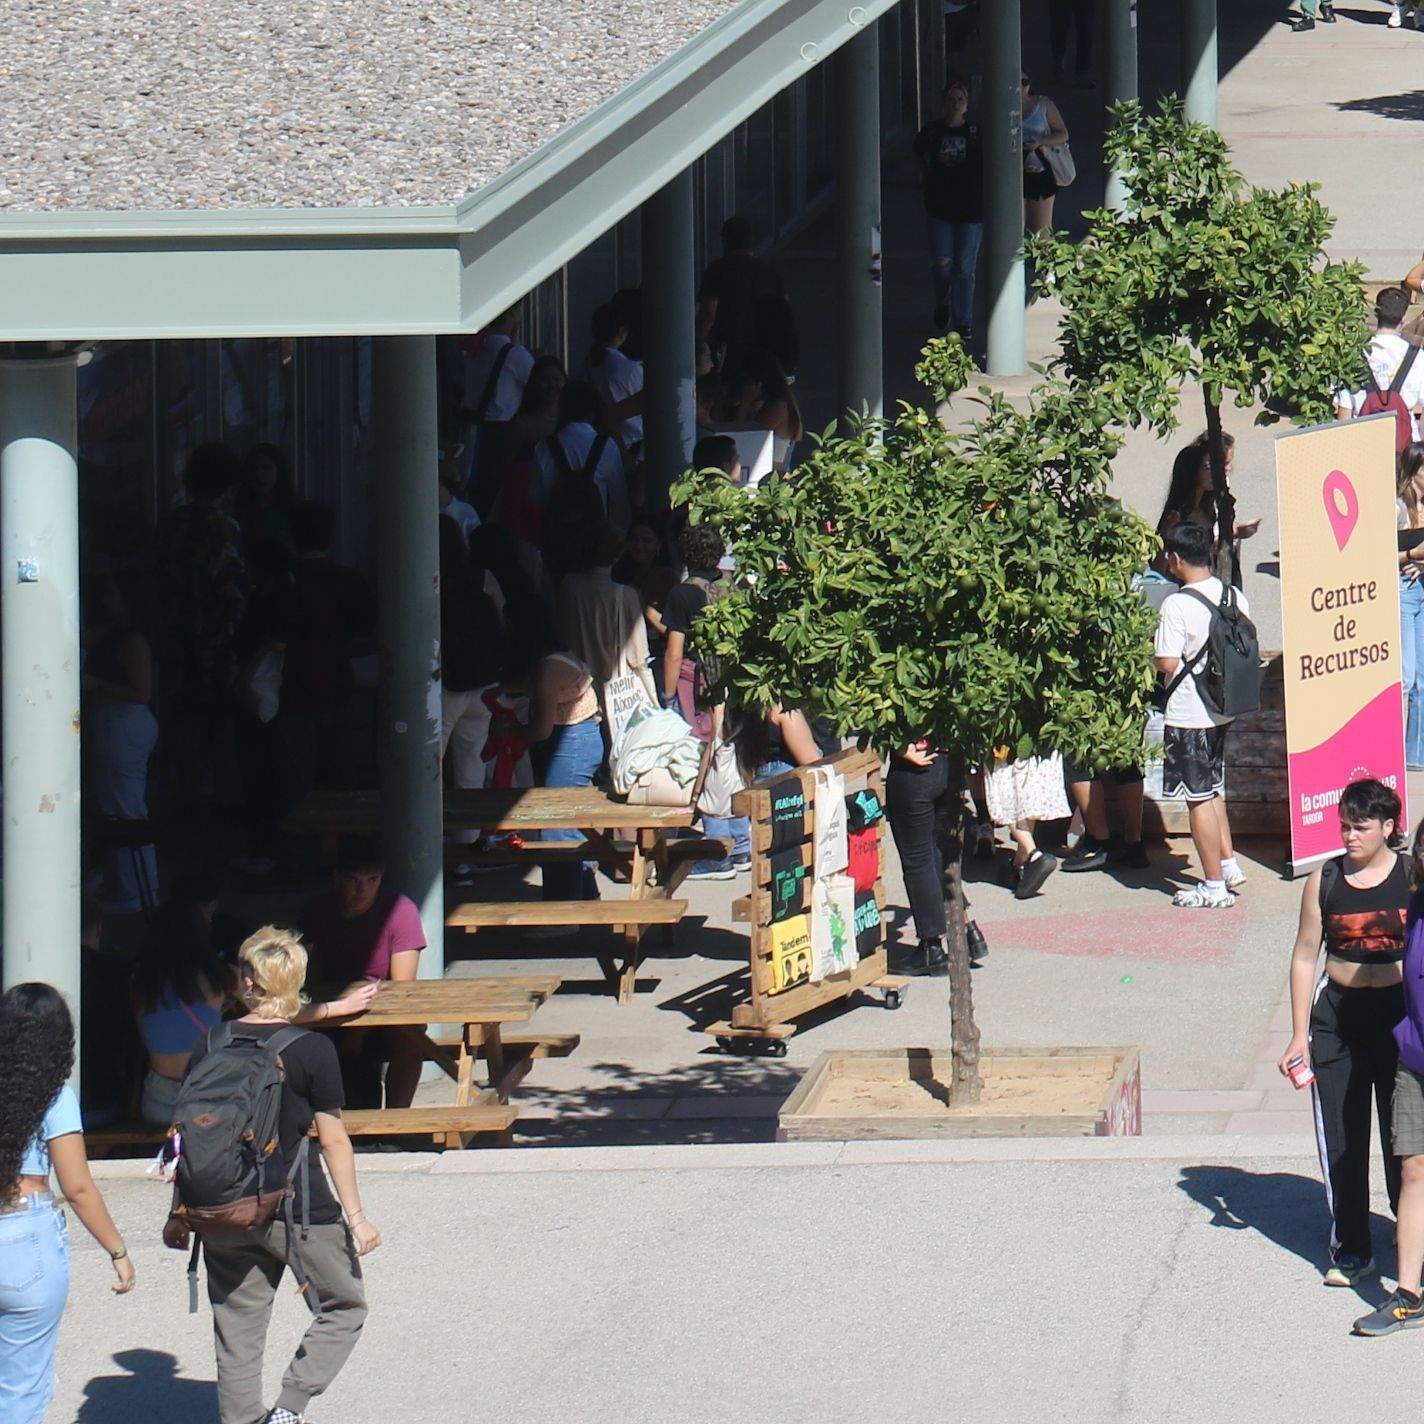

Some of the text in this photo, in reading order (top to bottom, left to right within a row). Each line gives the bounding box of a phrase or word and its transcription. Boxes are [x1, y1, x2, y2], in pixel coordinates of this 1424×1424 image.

[1309, 578, 1378, 614] Centre
[1332, 615, 1357, 643] de
[1299, 639, 1391, 681] Recursos
[1300, 792, 1312, 813] la
[1301, 811, 1324, 827] TARDOR
